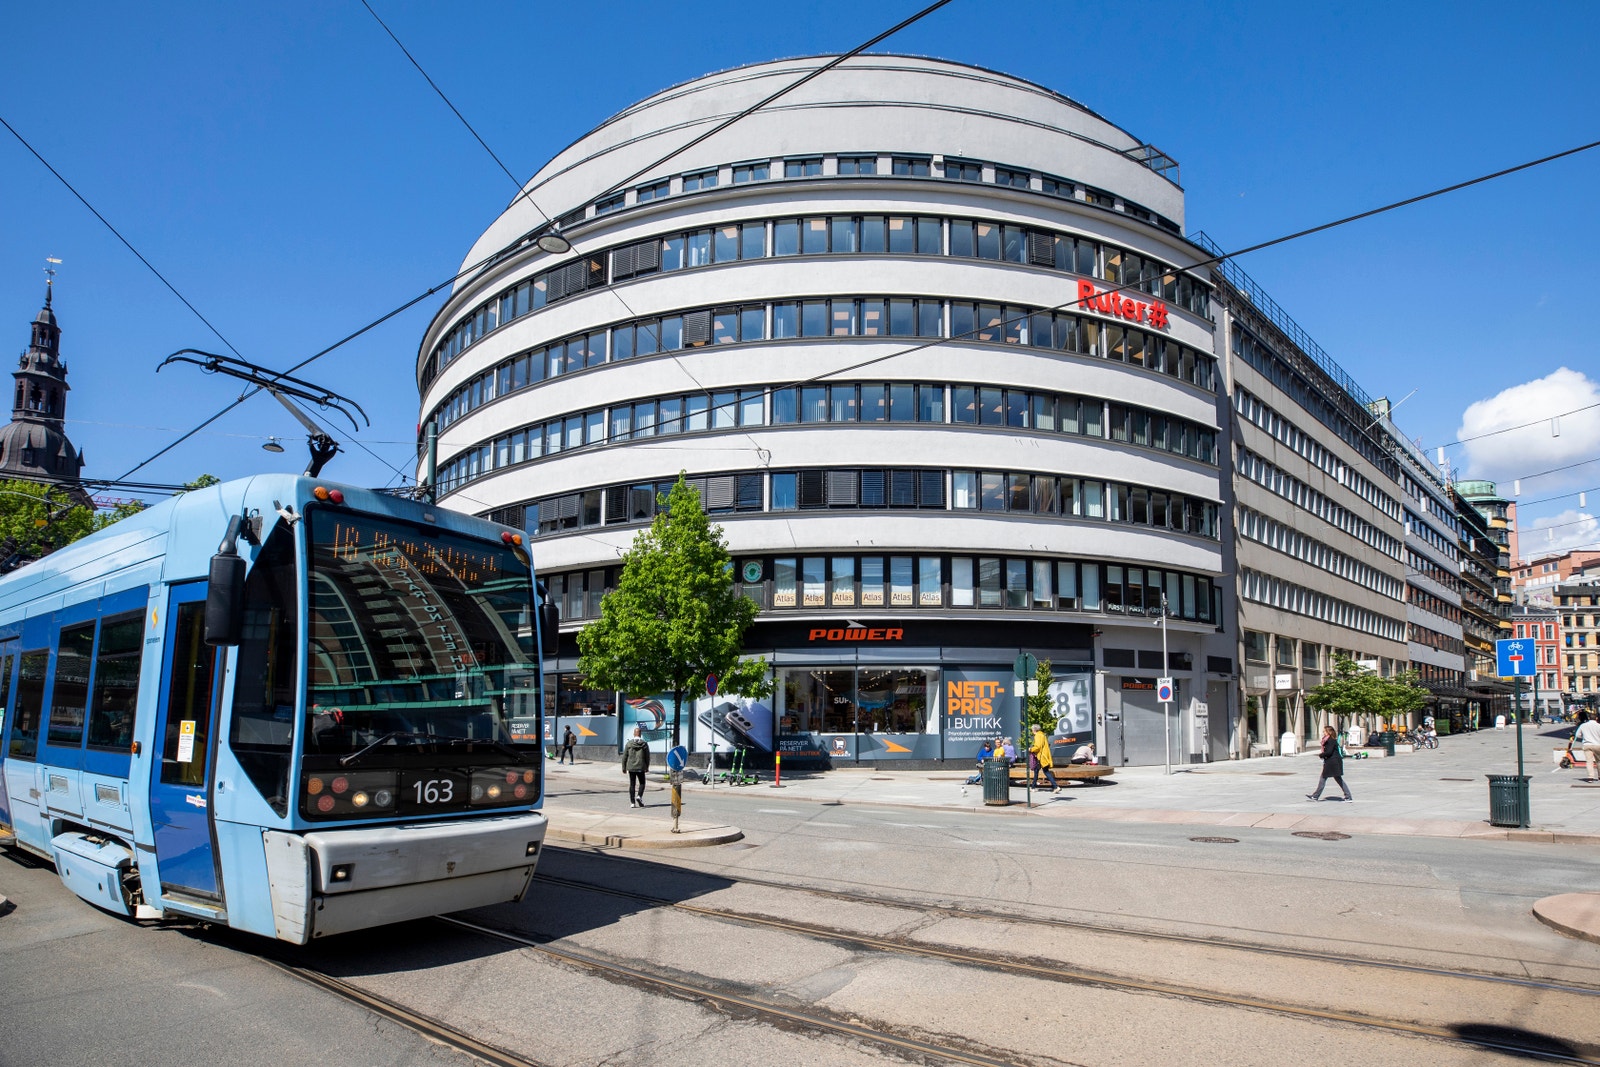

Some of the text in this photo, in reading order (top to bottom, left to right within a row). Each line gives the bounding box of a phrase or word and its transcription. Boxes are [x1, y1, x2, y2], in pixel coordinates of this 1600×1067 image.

[1077, 279, 1168, 328] Ruter#
[776, 594, 794, 602] Atlas
[805, 594, 823, 602] Atlas
[863, 593, 882, 601] Atlas
[893, 593, 911, 601] Atlas
[921, 593, 940, 601] Atlas
[808, 628, 904, 641] POWER
[948, 681, 1005, 698] NETT-
[1123, 682, 1153, 690] POWER
[948, 698, 993, 715] PRIS
[947, 717, 1002, 729] I BUTIKK
[413, 779, 453, 804] 163
